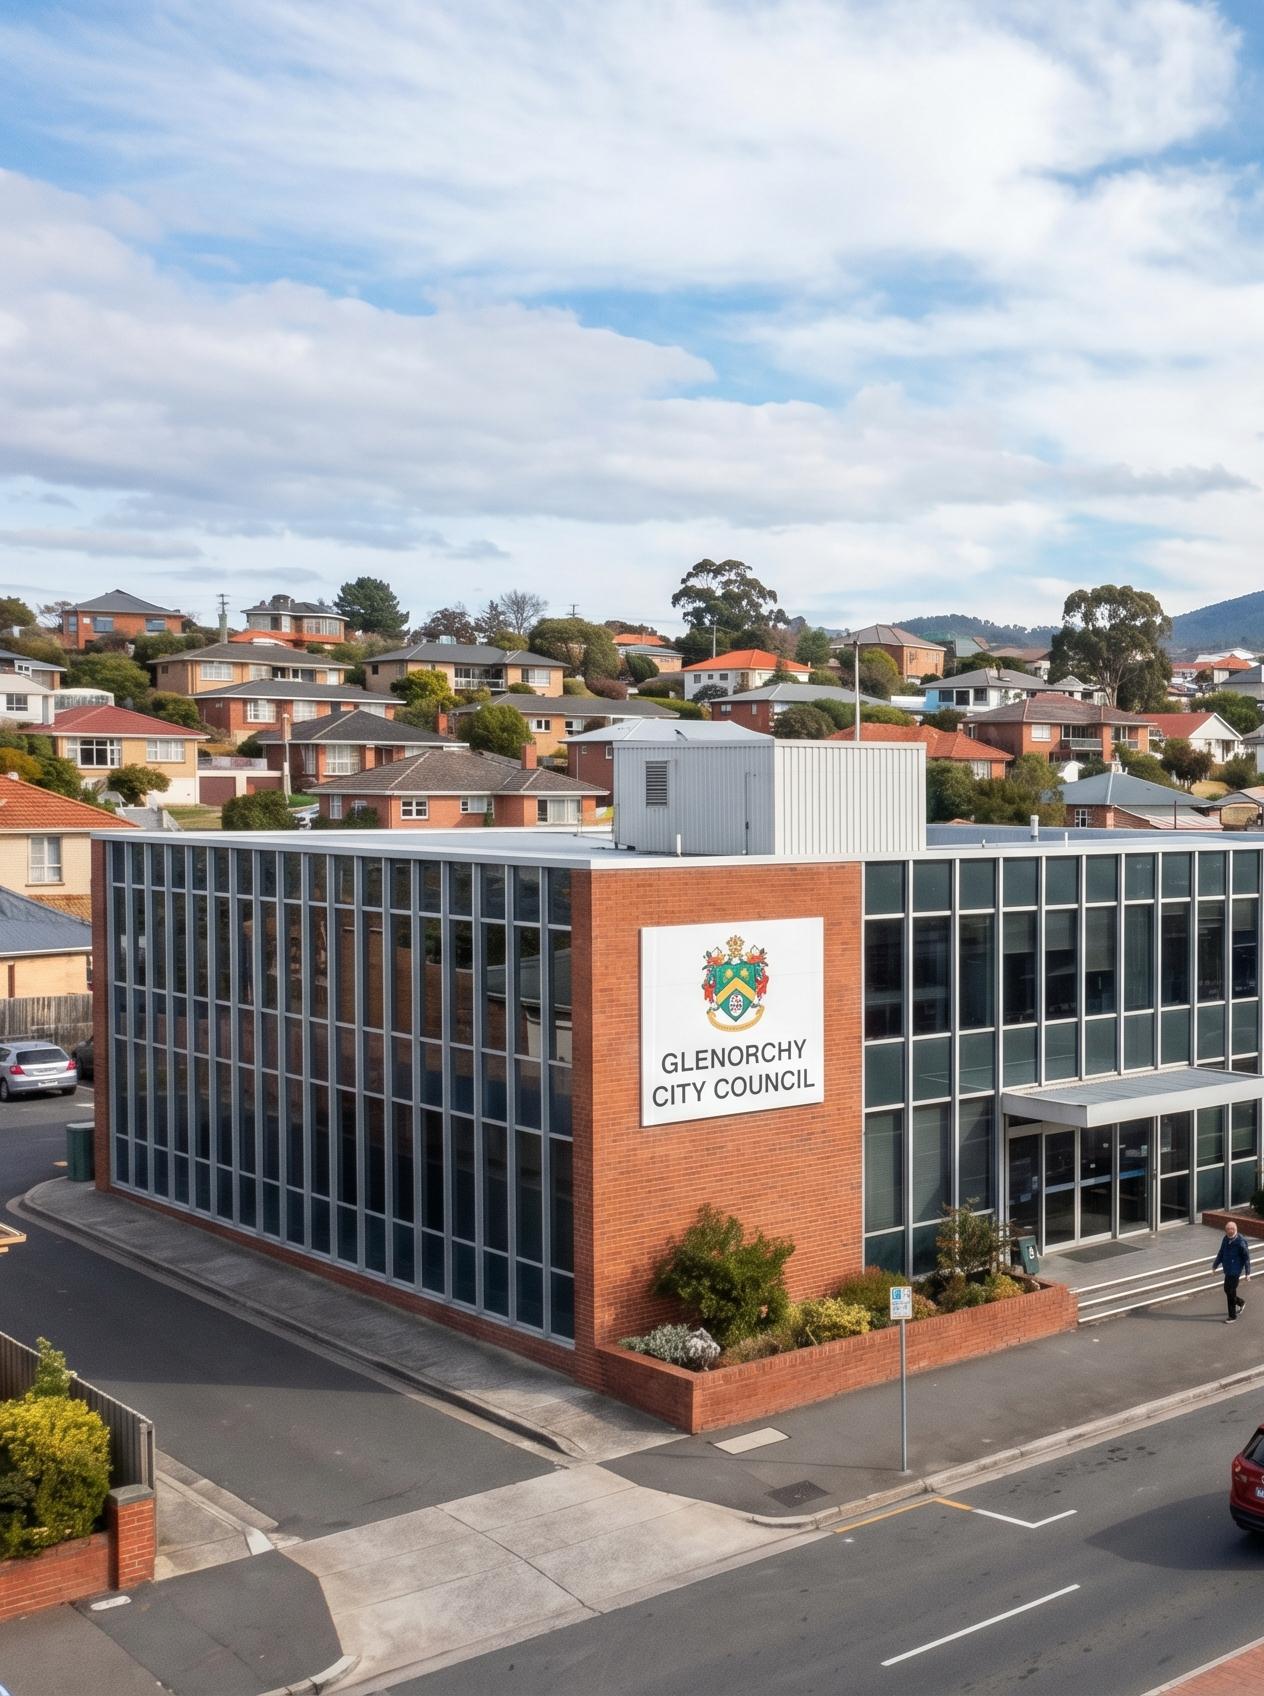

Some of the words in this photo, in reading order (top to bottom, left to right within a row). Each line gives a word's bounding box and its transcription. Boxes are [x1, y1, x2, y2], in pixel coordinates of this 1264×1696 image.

[661, 1038, 807, 1074] GLENORCHY
[652, 1080, 706, 1107] CITY
[714, 1068, 815, 1099] COUNCIL
